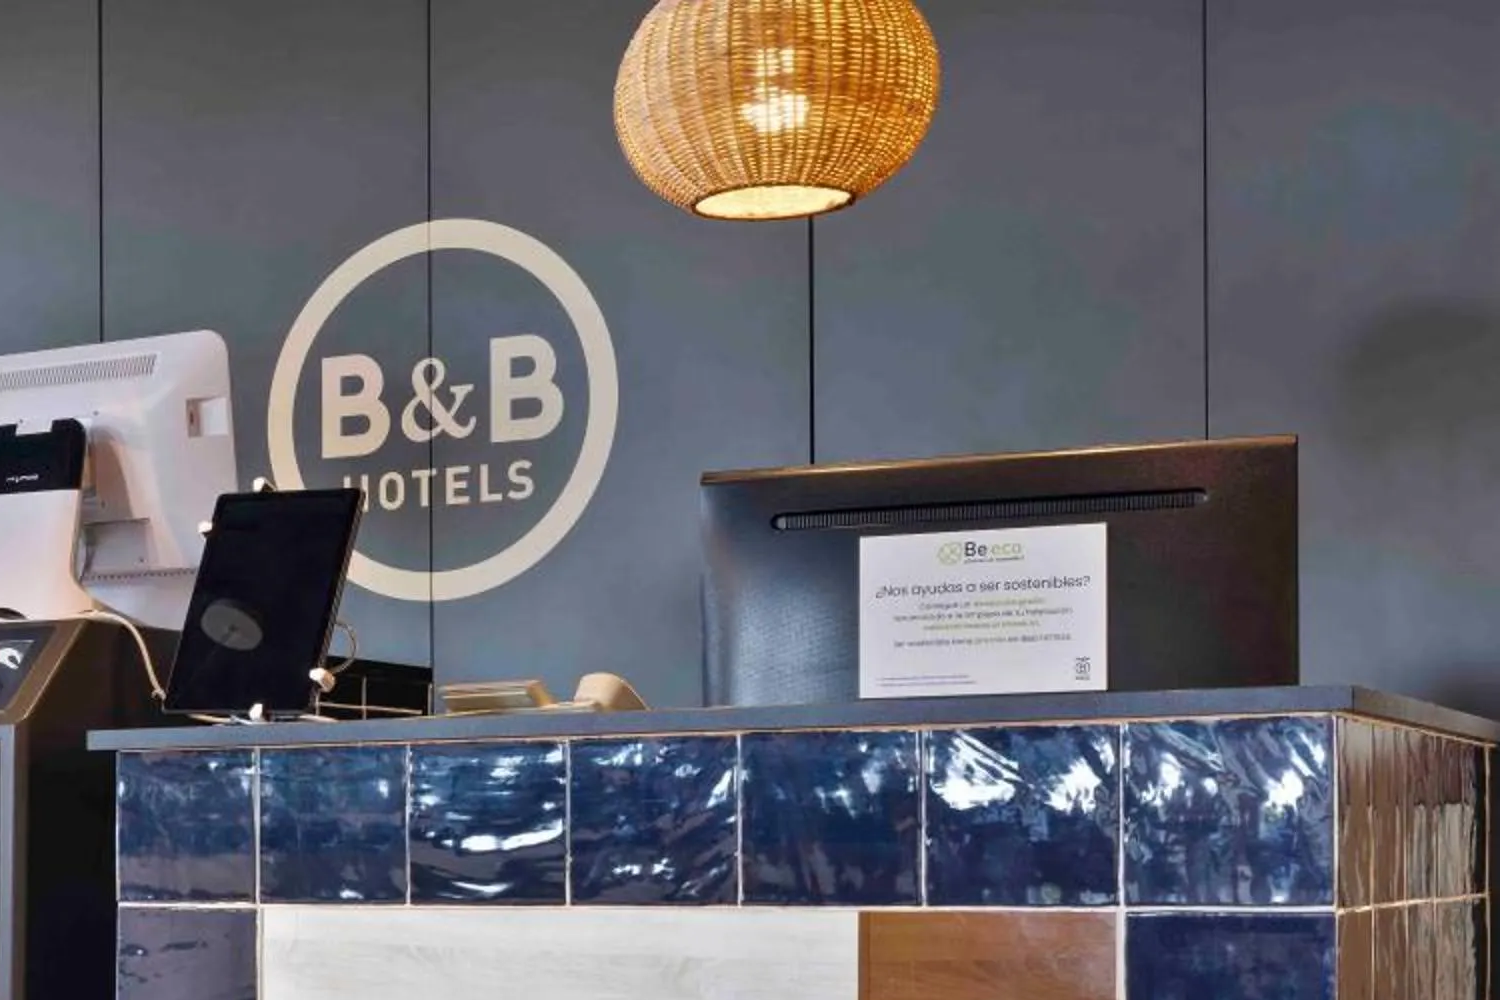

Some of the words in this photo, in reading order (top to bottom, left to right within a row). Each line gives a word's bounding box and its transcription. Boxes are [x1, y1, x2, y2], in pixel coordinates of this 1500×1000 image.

[321, 334, 564, 459] B&B
[964, 541, 987, 557] Be
[991, 542, 1022, 556] eco
[911, 581, 962, 598] ayudas
[966, 583, 976, 593] a
[979, 580, 1000, 591] ser
